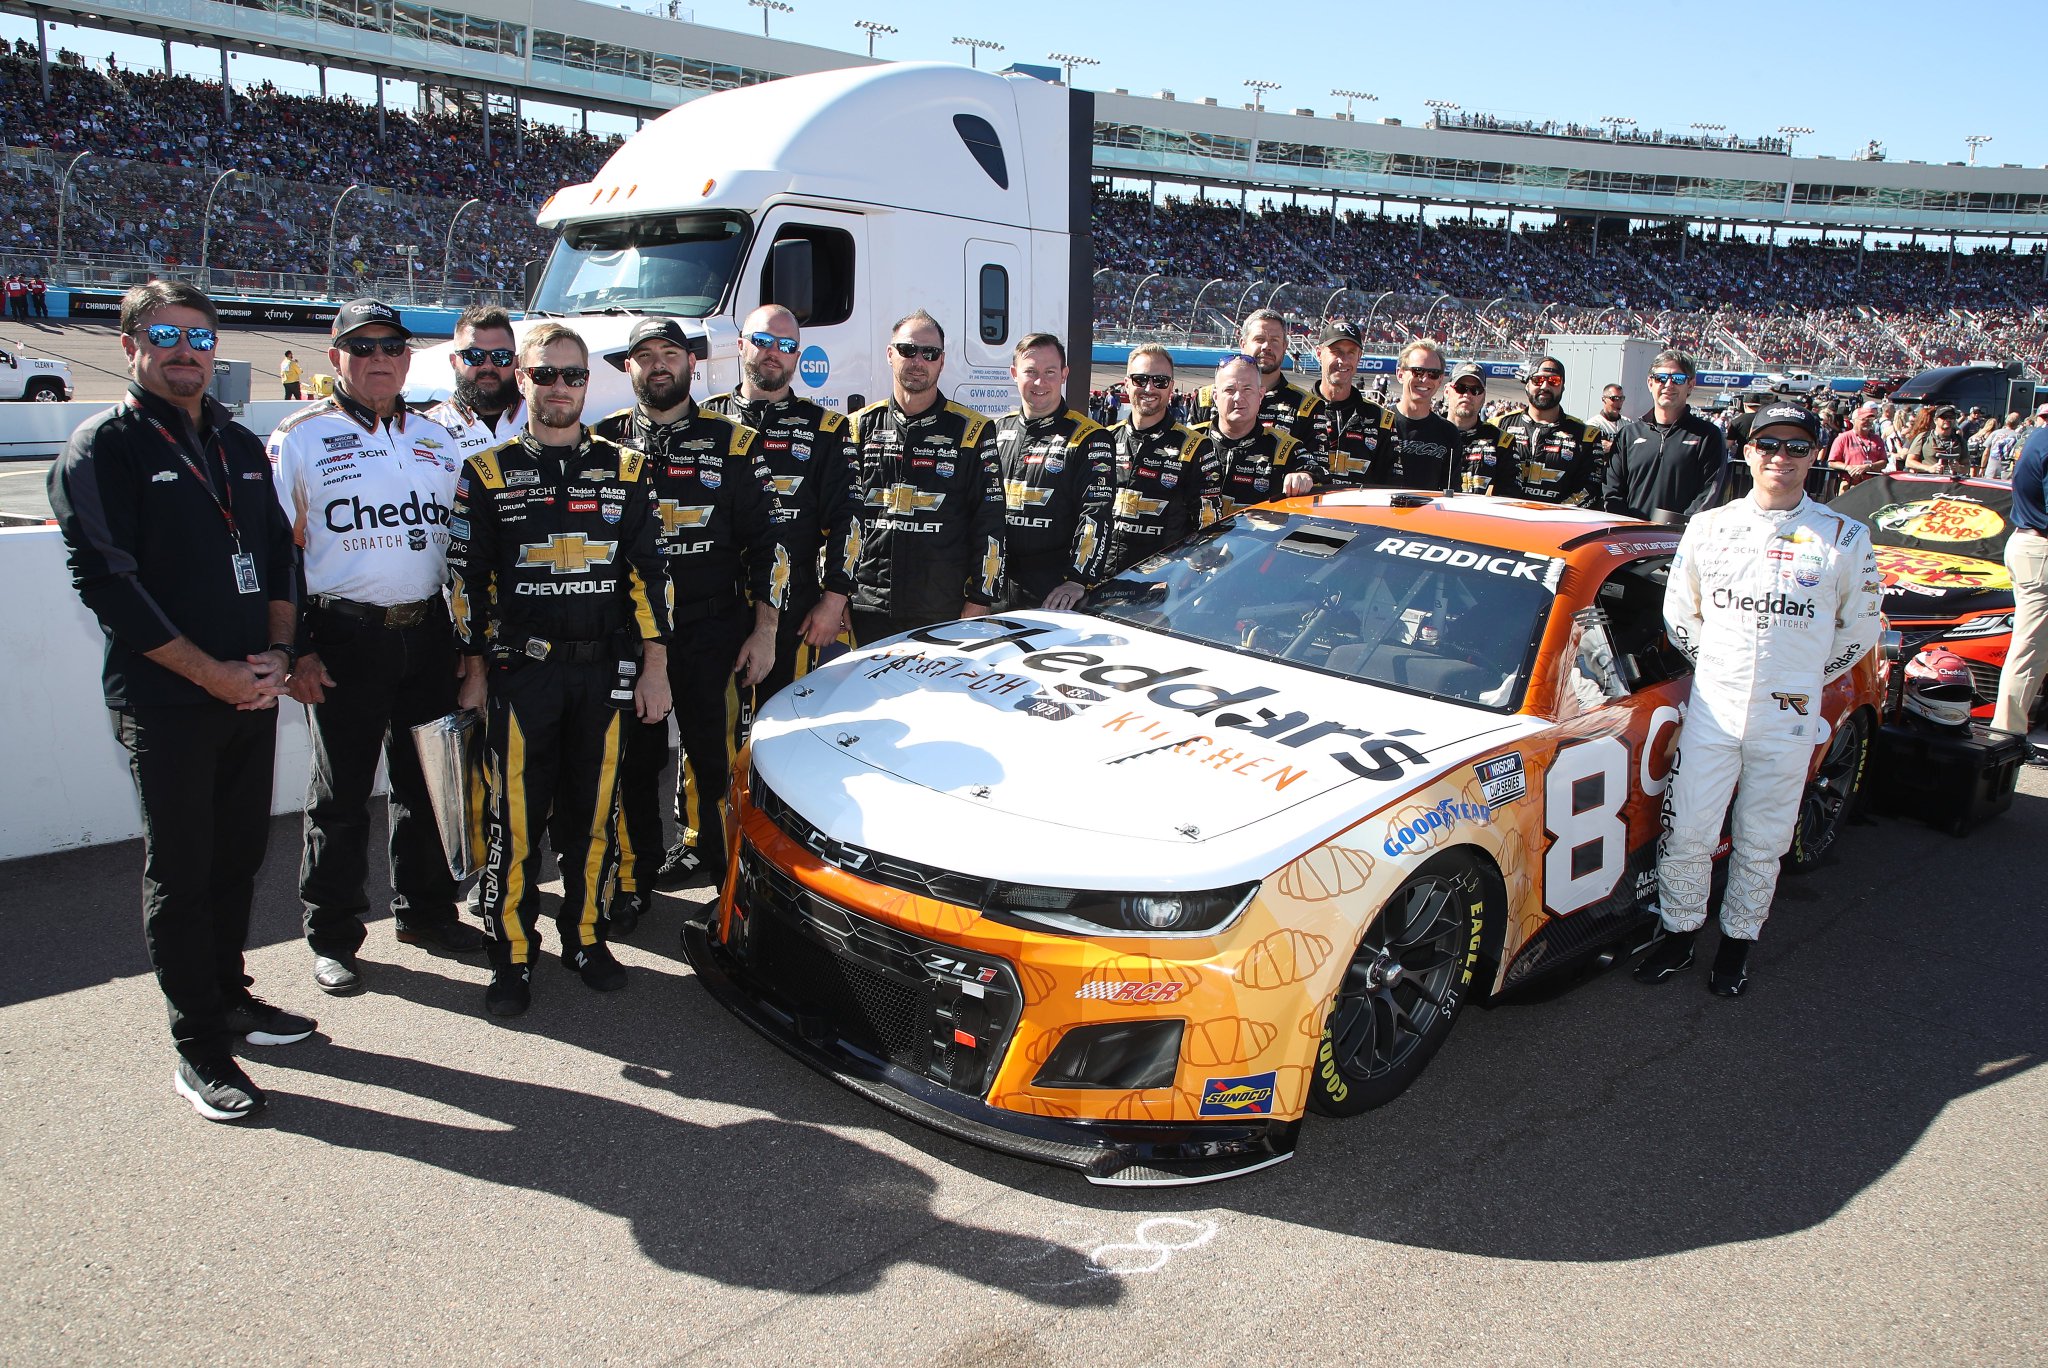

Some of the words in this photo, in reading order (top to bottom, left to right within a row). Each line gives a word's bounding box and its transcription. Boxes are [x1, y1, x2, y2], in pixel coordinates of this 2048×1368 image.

[264, 309, 294, 321] xfinity
[315, 313, 336, 321] CHAMP
[34, 361, 49, 369] CLEAN
[50, 361, 54, 369] 4
[800, 360, 828, 374] csm
[1491, 366, 1518, 375] GEIC
[1703, 375, 1740, 385] GEICO
[810, 396, 839, 407] uction
[970, 390, 985, 398] GVW
[986, 390, 1009, 398] 80,000
[988, 405, 1011, 413] 1034385
[1767, 407, 1806, 420] Cheddar's
[460, 438, 487, 448] 3CHI
[358, 450, 388, 459] 3CHI
[324, 463, 357, 473] OKUMA
[473, 455, 494, 481] sparco
[528, 487, 557, 496] 3CHI
[600, 486, 626, 496] ALSCO
[1930, 500, 1983, 518] Bass
[864, 518, 943, 533] CHEVROLET
[1924, 511, 1965, 526] Pro
[1841, 524, 1861, 548] sparco
[1918, 521, 1984, 540] Shops
[343, 535, 403, 552] SCRATCH
[1373, 537, 1546, 582] REDDICK
[514, 580, 617, 596] CHEVROLET
[1712, 588, 1815, 619] Cheddar's
[1773, 619, 1809, 630] KITCHEN
[906, 617, 1431, 782] Cheddar's
[1771, 691, 1810, 715] TR
[1028, 702, 1060, 717] 1979
[1102, 710, 1309, 792] KITCHEN
[1491, 757, 1516, 777] NASCAR
[1489, 782, 1501, 797] CUP
[1500, 776, 1520, 794] SERIES
[1382, 797, 1492, 858] GOODYEAR
[1543, 735, 1631, 917] 8
[485, 822, 503, 941] CHEVROLET
[1635, 868, 1659, 889] ALSC
[1636, 882, 1659, 900] UNIFOR
[1460, 900, 1484, 986] EAGLE
[924, 953, 998, 983] ZL1
[1112, 981, 1185, 1001] RCR
[1318, 1035, 1349, 1104] GOOD
[1205, 1087, 1271, 1105] SUNOCO
